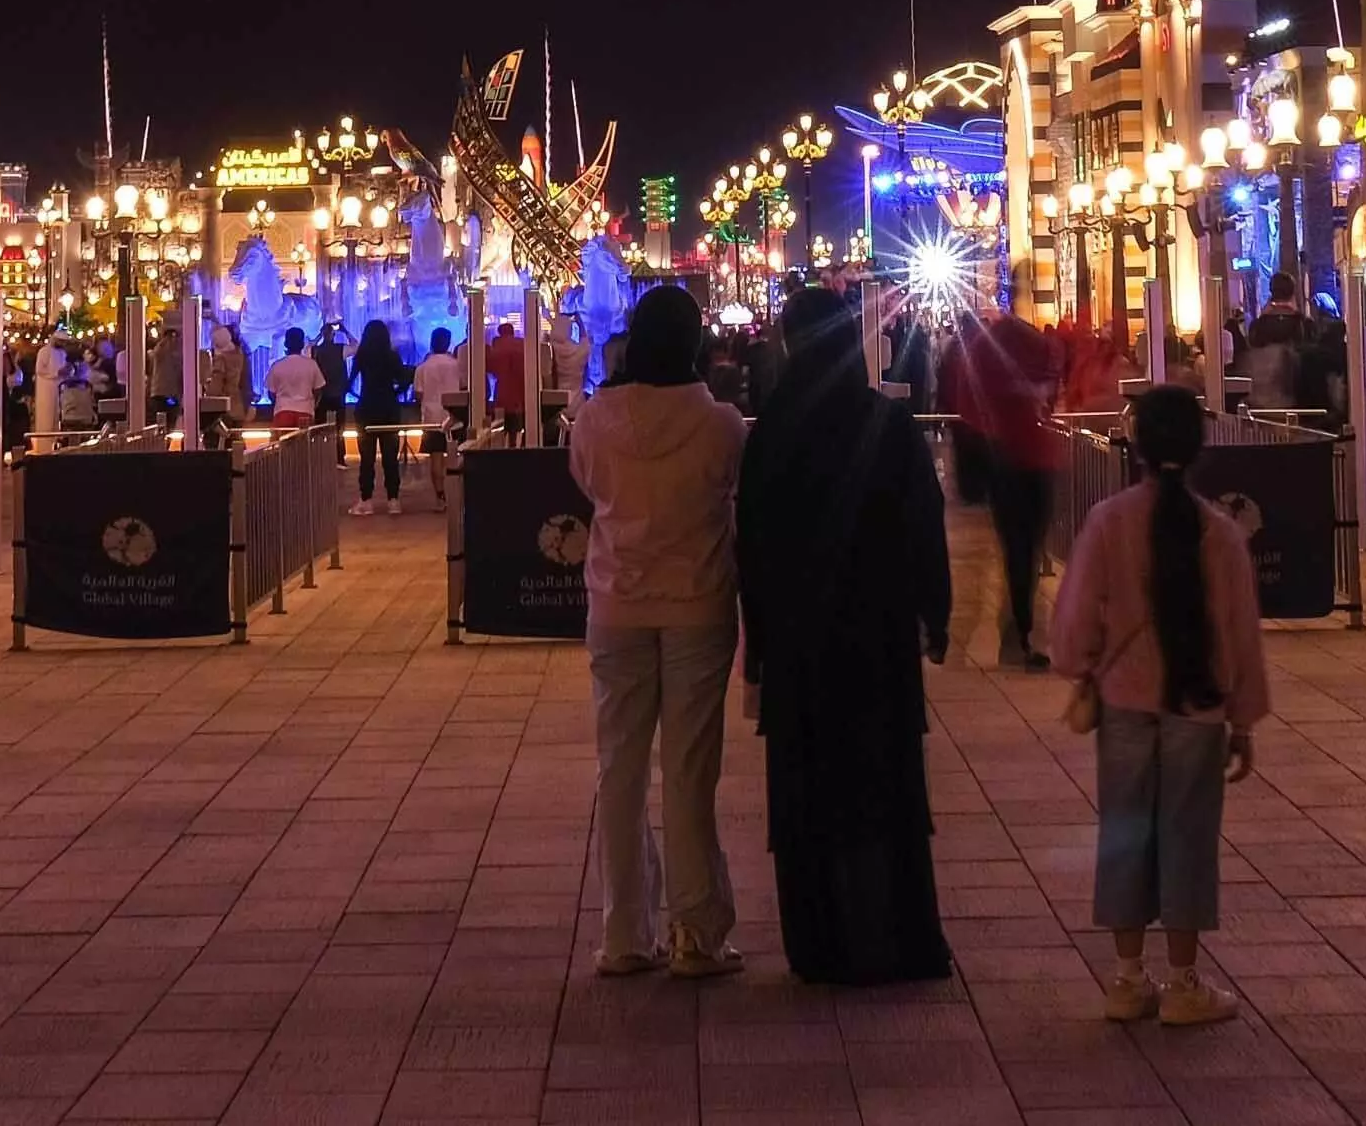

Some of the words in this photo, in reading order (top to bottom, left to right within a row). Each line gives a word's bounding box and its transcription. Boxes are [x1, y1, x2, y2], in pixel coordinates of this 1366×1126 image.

[216, 167, 310, 187] AMERICAS
[82, 592, 124, 606] Global
[129, 592, 175, 608] Village
[520, 593, 562, 605] Global
